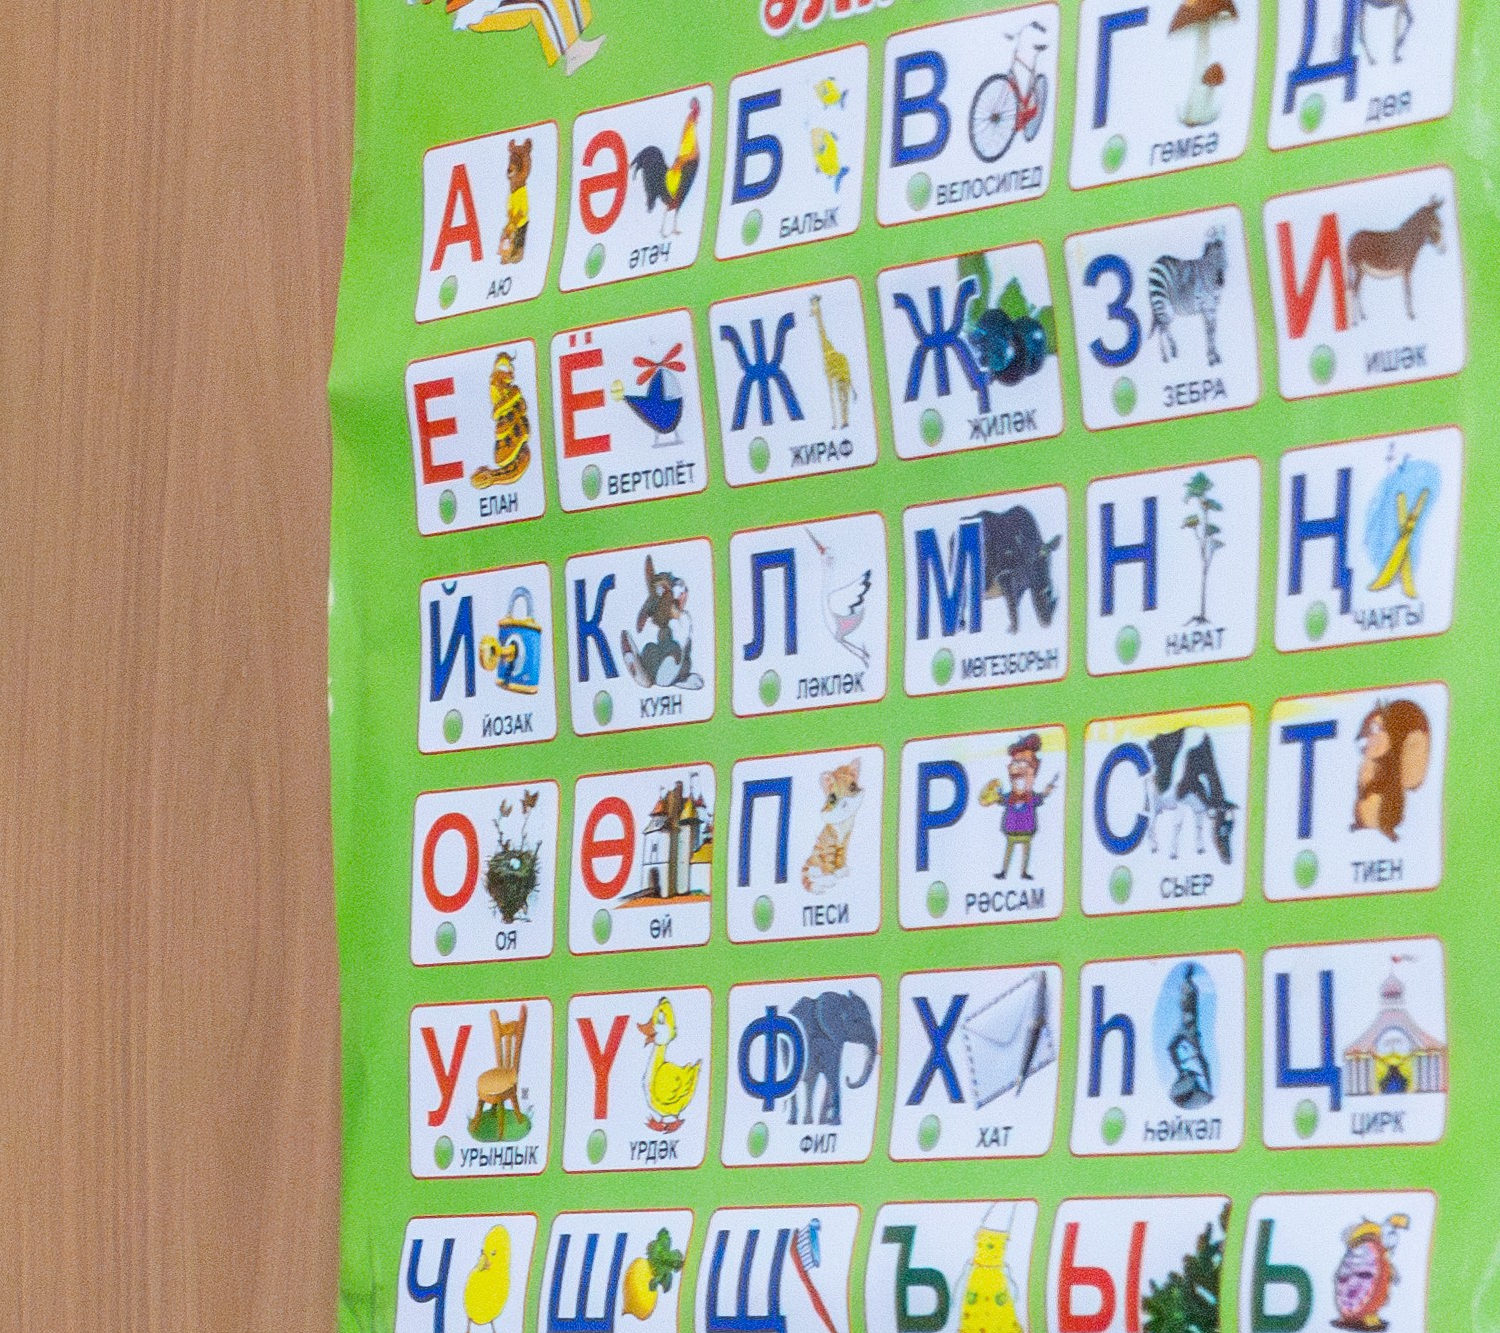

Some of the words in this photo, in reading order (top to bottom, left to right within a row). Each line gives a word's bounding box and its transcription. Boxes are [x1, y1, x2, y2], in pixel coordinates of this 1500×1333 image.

[890, 49, 951, 167] В
[1092, 6, 1149, 129] Г
[1283, 0, 1360, 114] Д
[578, 130, 628, 234] Ә
[730, 89, 783, 206] Б
[936, 166, 1043, 206] ВЕЛОСИПЕД
[430, 164, 484, 271] А
[779, 207, 839, 239] БАЛЫК
[486, 277, 512, 299] АЮ
[1083, 254, 1142, 367] З
[1276, 212, 1348, 339] И
[559, 332, 611, 458] Ё
[720, 312, 804, 431] Ж
[892, 278, 991, 413] Җ
[1163, 377, 1228, 408] ЗЕБРА
[413, 377, 464, 485] Е
[607, 462, 695, 495] ВЕРТОЛЁТ
[790, 438, 854, 468] ЖИРАФ
[479, 492, 518, 517] ЕЛАН
[1100, 496, 1158, 616] Н
[1287, 467, 1354, 615] Ң
[572, 573, 619, 682] К
[743, 548, 798, 661] Л
[915, 522, 984, 640] М
[429, 581, 476, 702] Й
[797, 670, 865, 700] ЛӘКЛӘК
[1165, 627, 1226, 655] НАРАТ
[482, 711, 533, 737] ЙОЗАК
[639, 693, 683, 719] КУЯН
[915, 760, 969, 872] Р
[1093, 742, 1151, 856] С
[1280, 719, 1339, 839] Т
[422, 812, 479, 913] О
[581, 796, 636, 900] Ө
[737, 776, 793, 888] П
[1352, 858, 1403, 882] ТИЕН
[650, 911, 673, 939] ӨЙ
[802, 902, 850, 927] ПЕСИ
[965, 888, 1045, 915] РӘССАМ
[1160, 874, 1214, 900] СЫЕР
[495, 930, 517, 952] ОЯ
[420, 1024, 473, 1127] У
[576, 1015, 630, 1120] Ү
[737, 1005, 806, 1113] Ф
[906, 993, 969, 1107] Х
[1275, 970, 1342, 1112] Ц
[459, 1145, 540, 1170] УРЫНДЫК
[629, 1140, 679, 1162] ҮРДӘК
[800, 1132, 837, 1154] ФИЛ
[976, 1125, 1012, 1149] ХАТ
[1351, 1110, 1406, 1136] ЦИРК
[882, 1225, 951, 1333] Ъ
